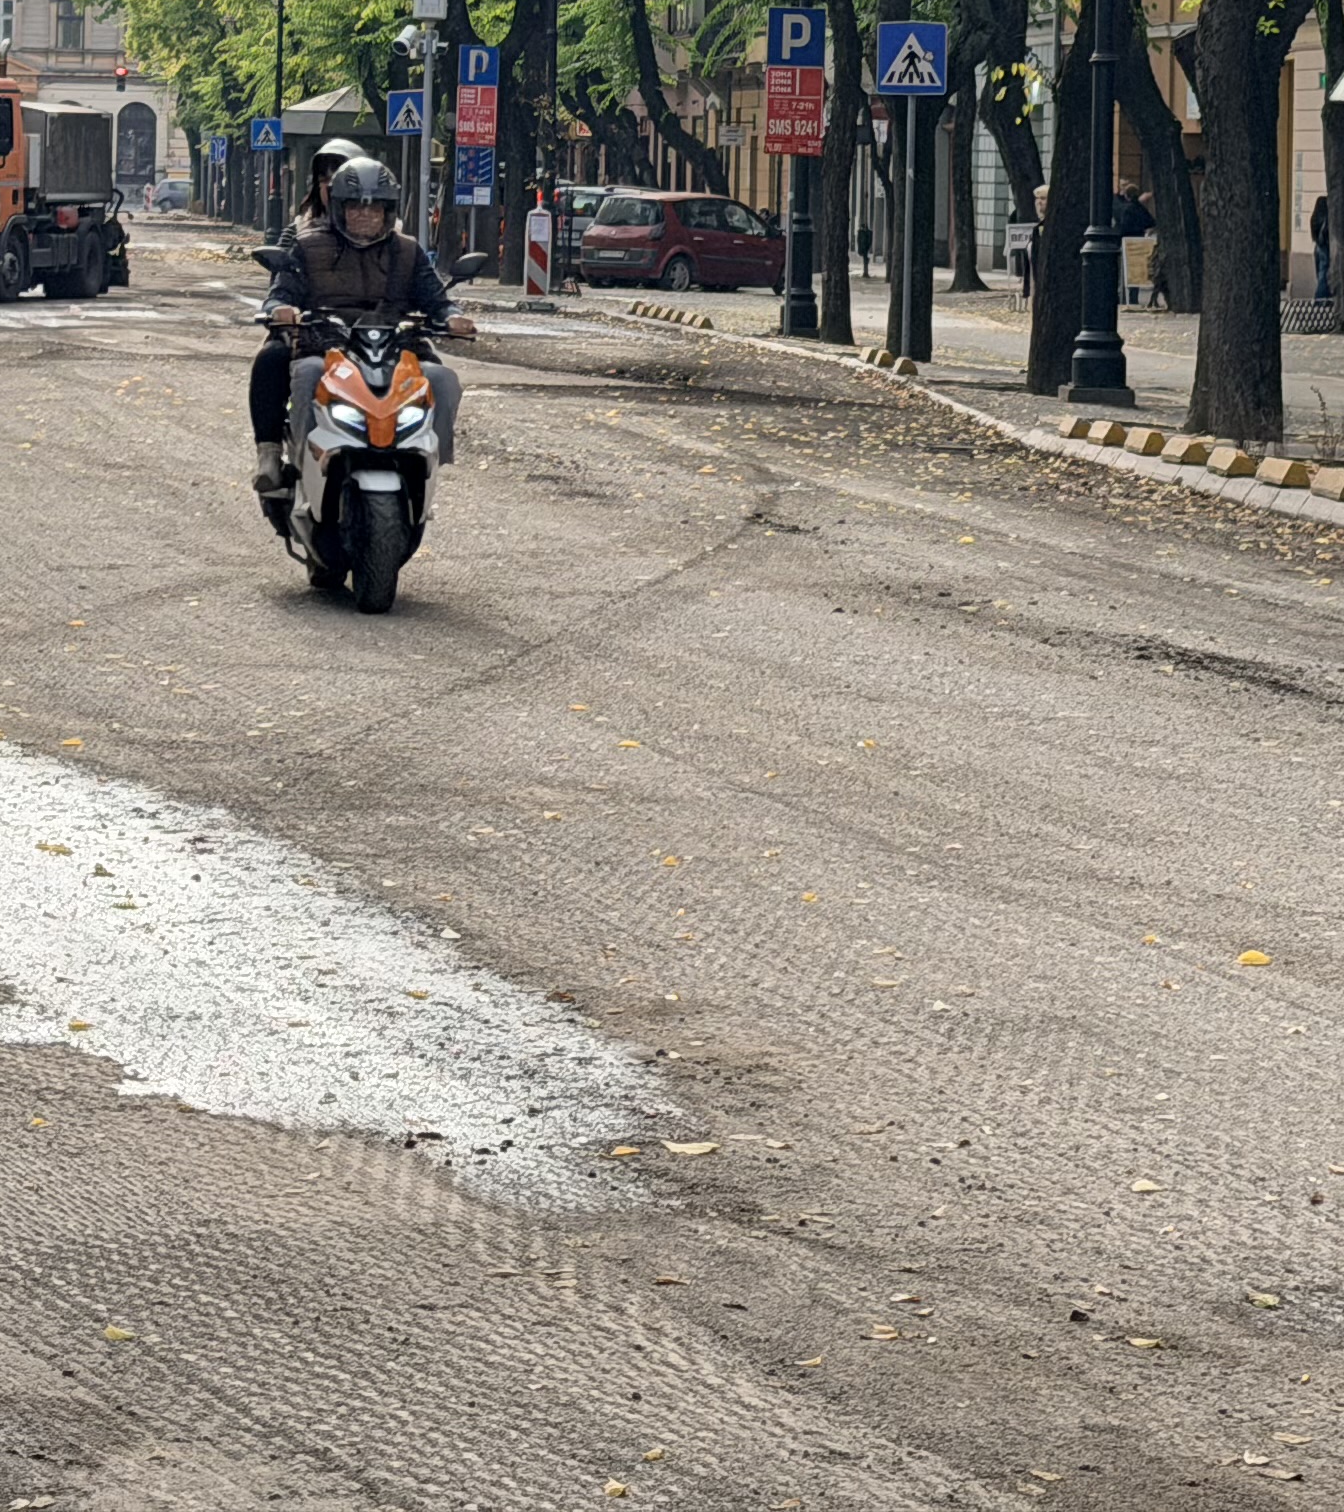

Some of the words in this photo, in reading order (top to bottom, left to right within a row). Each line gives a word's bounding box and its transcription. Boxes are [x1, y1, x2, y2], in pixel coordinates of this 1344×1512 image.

[781, 13, 811, 60] P
[468, 49, 489, 81] P
[768, 119, 792, 135] SMS
[794, 119, 818, 136] 9241
[1011, 233, 1032, 242] BEN
